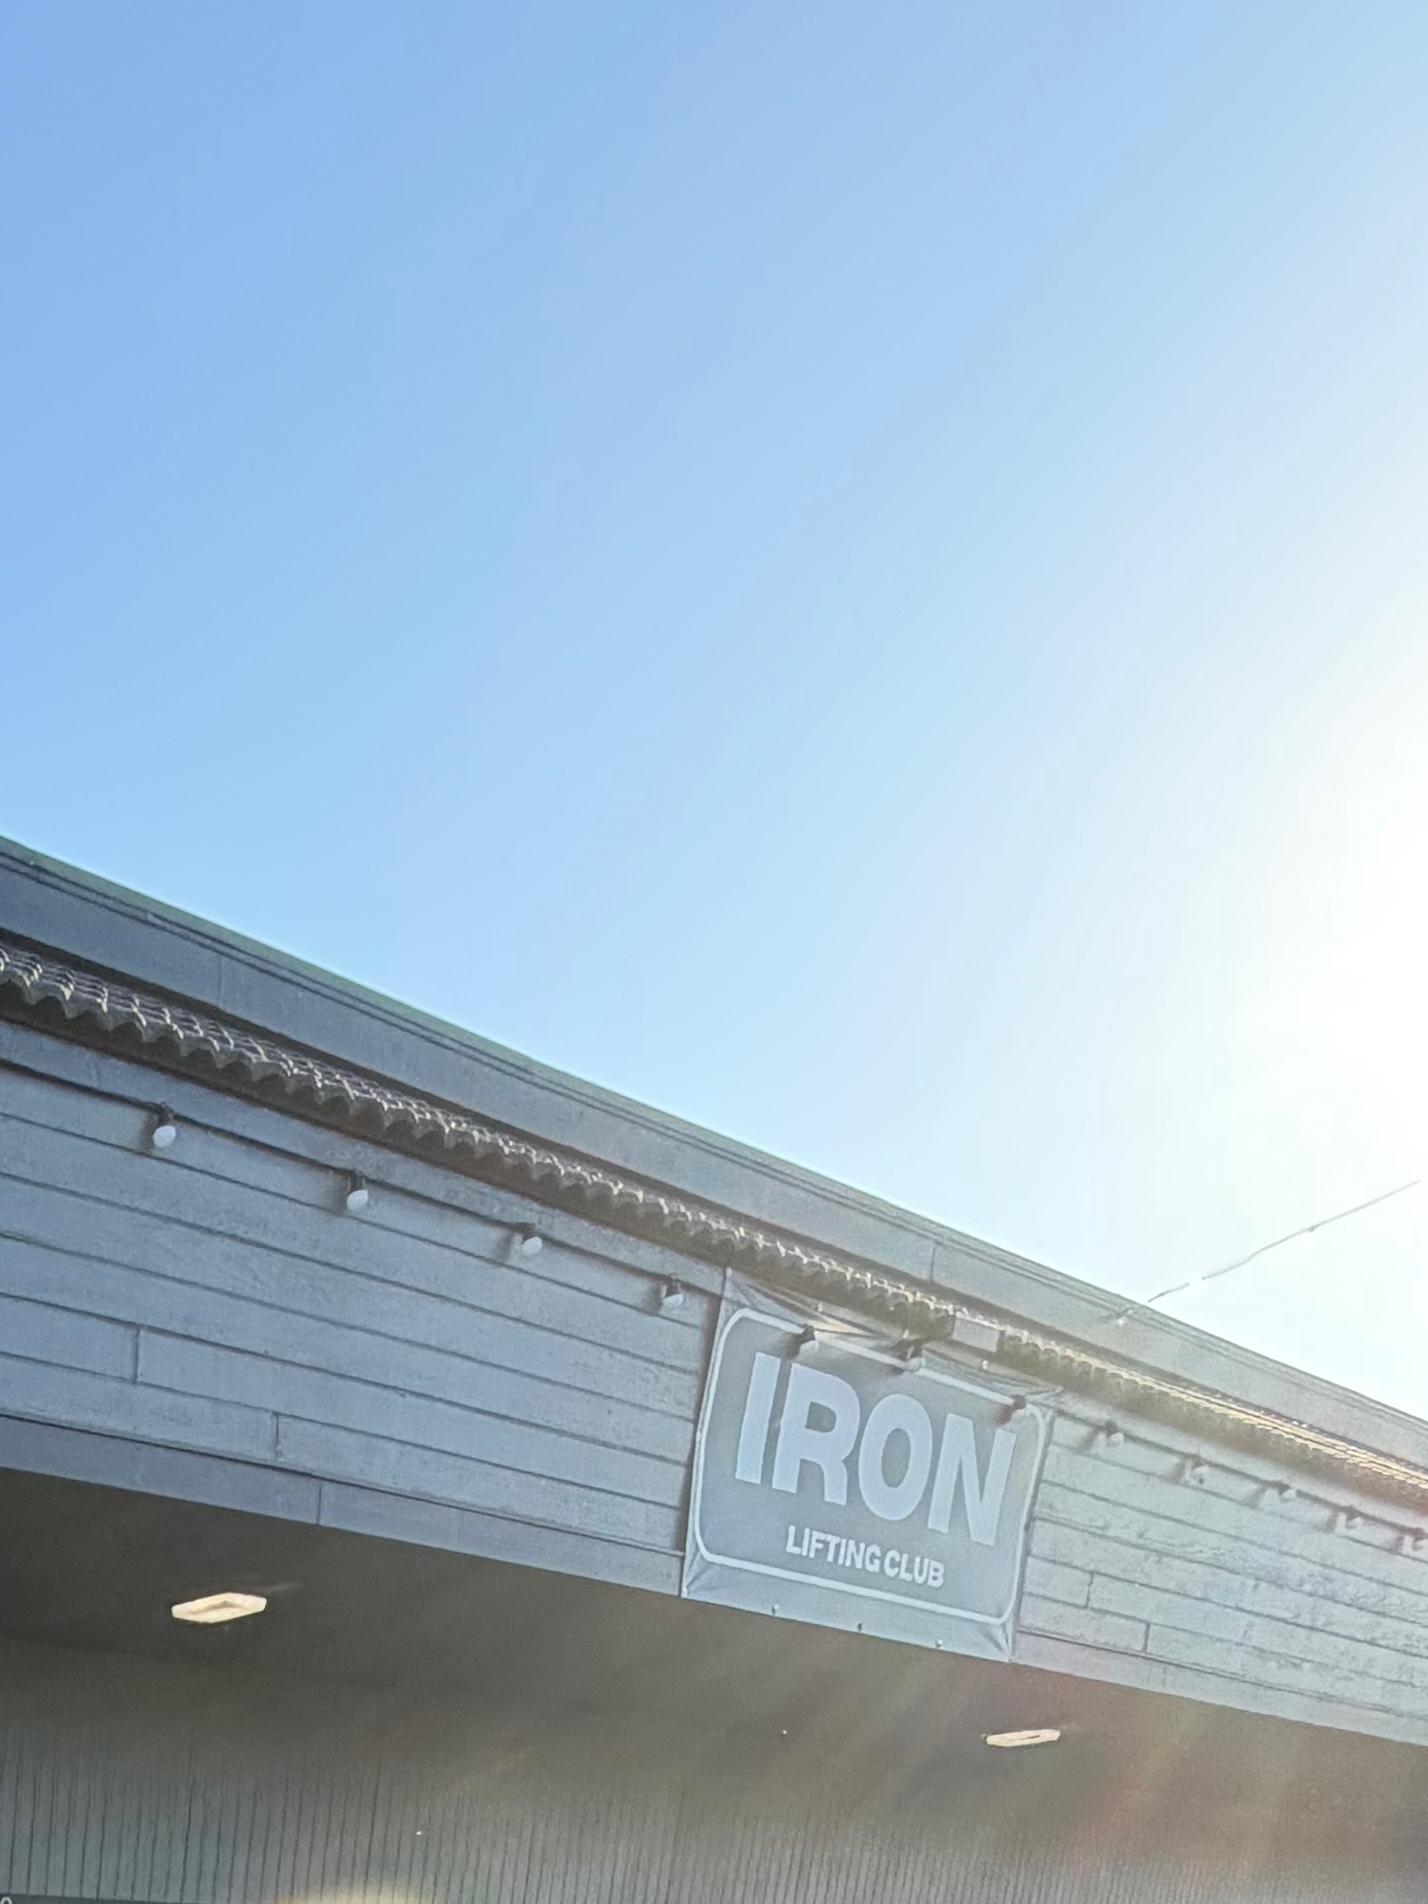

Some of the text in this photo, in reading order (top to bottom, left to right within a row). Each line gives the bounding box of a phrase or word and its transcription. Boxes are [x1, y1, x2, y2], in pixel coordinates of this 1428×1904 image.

[734, 1351, 1017, 1546] IRON
[786, 1525, 946, 1588] LIFTING CLUB
